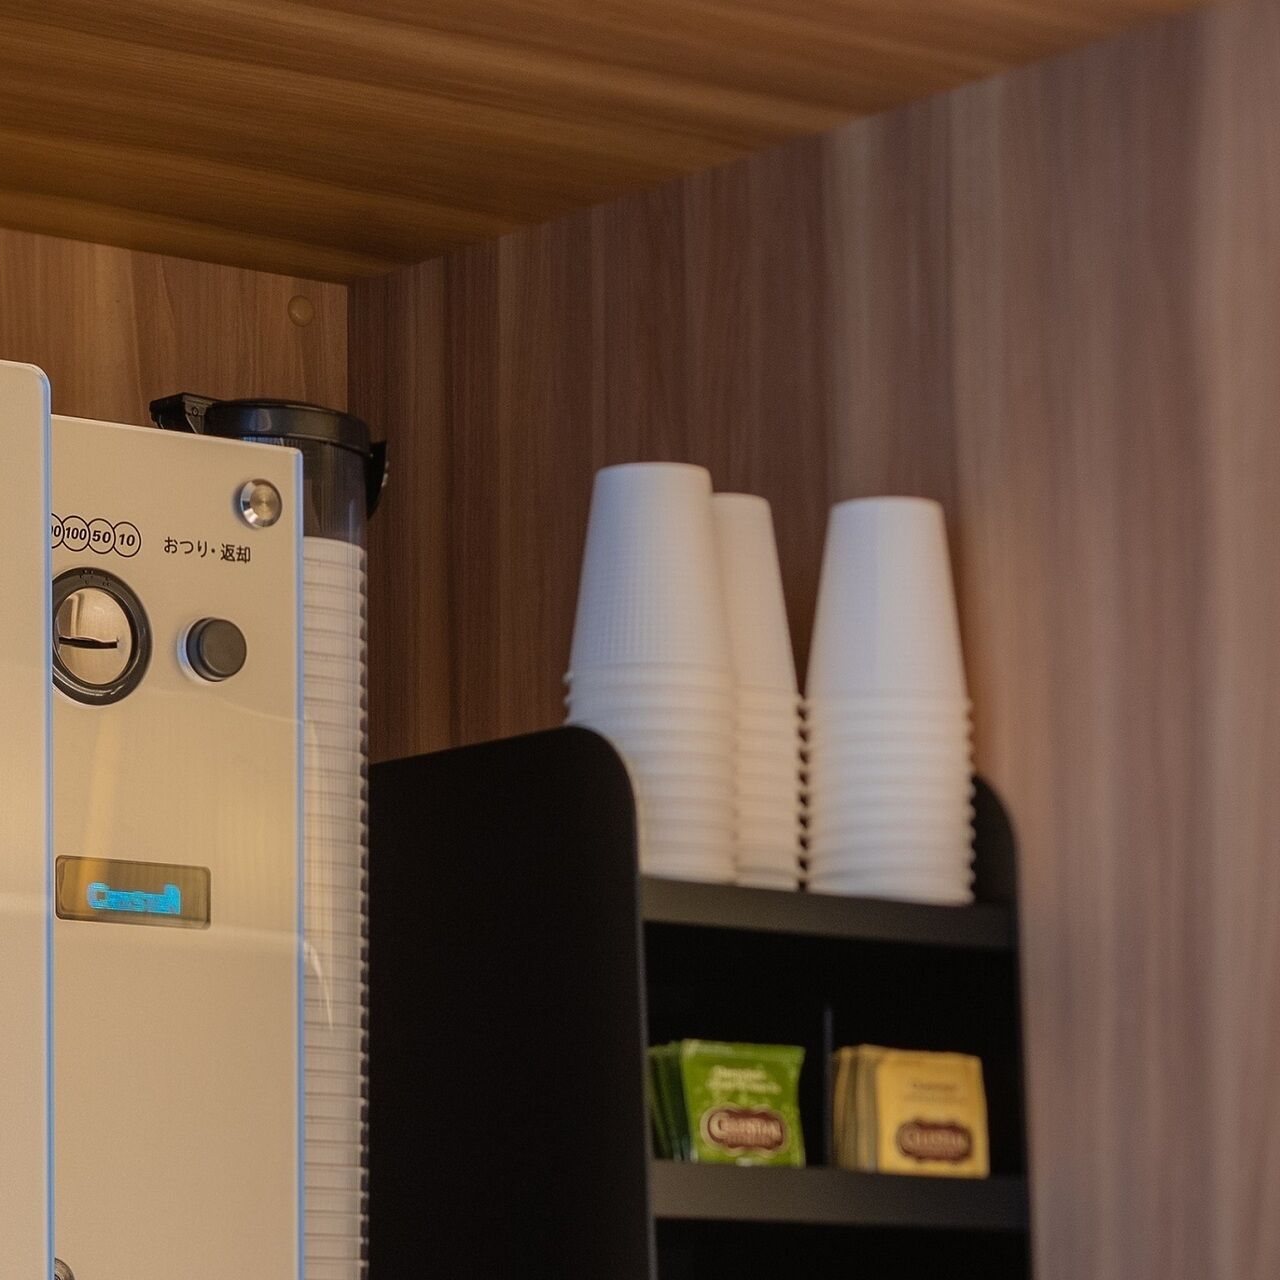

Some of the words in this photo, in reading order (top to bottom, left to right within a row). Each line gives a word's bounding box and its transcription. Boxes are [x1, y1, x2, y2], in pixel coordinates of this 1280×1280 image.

[65, 527, 87, 541] 100
[92, 530, 111, 543] 50
[119, 533, 135, 546] 10
[164, 537, 251, 563] おつり・返却
